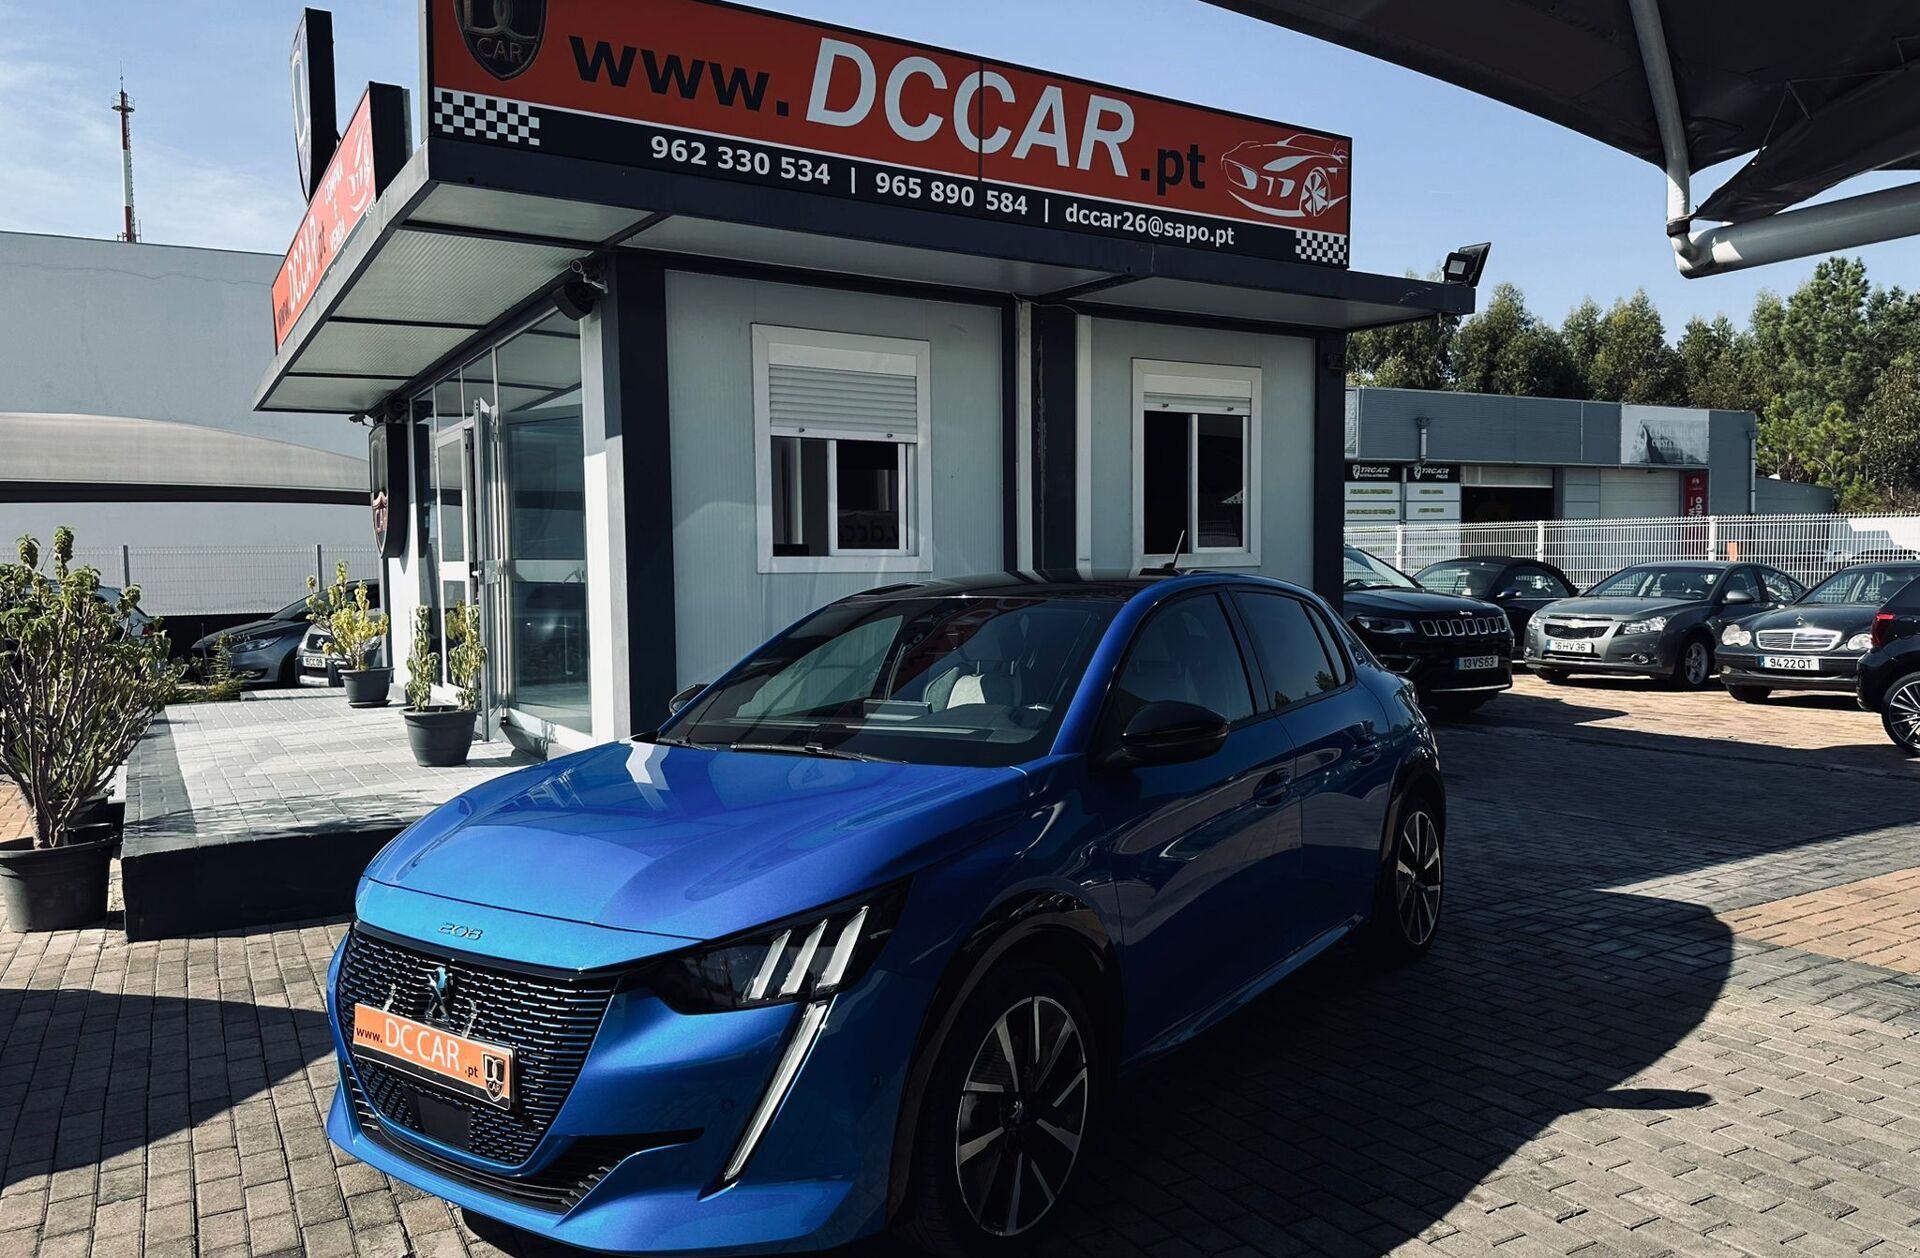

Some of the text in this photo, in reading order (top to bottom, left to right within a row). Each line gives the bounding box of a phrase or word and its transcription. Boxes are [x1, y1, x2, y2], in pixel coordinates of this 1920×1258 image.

[477, 36, 524, 64] CAR
[650, 136, 1235, 246] 962 330 534 965 890 584 dccar26@sapo.pt
[438, 921, 484, 941] 208
